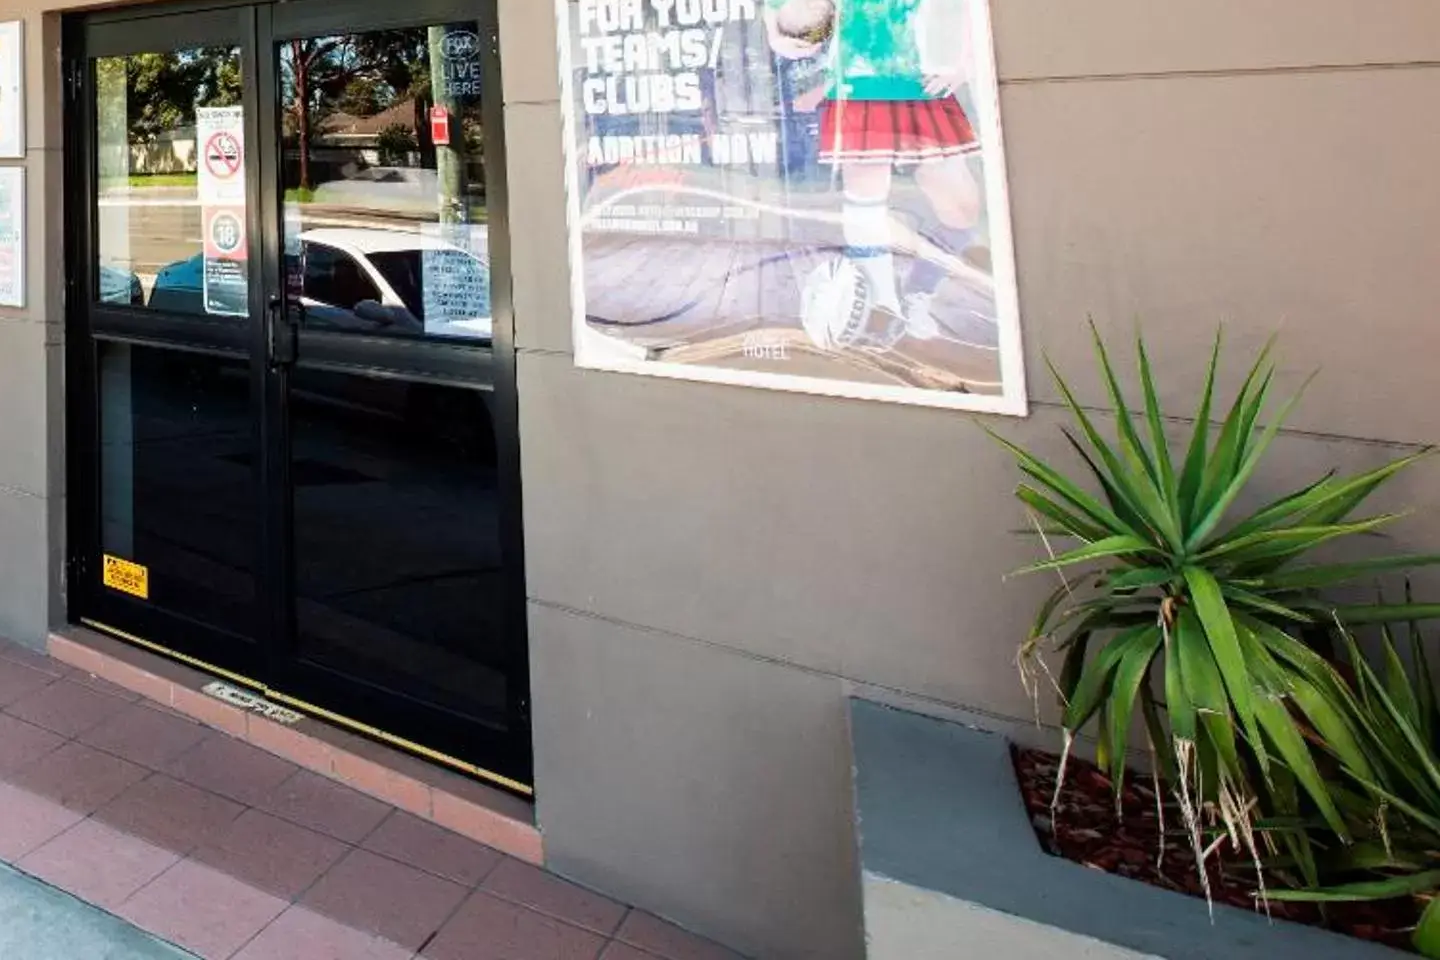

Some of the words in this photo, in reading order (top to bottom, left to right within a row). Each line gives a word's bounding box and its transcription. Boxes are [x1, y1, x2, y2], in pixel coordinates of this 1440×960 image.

[580, 27, 724, 75] TEAMS/
[441, 62, 481, 81] LIVE
[443, 80, 481, 96] HERE
[582, 72, 702, 115] CLUBS
[711, 133, 778, 165] NOW
[218, 226, 236, 247] 18
